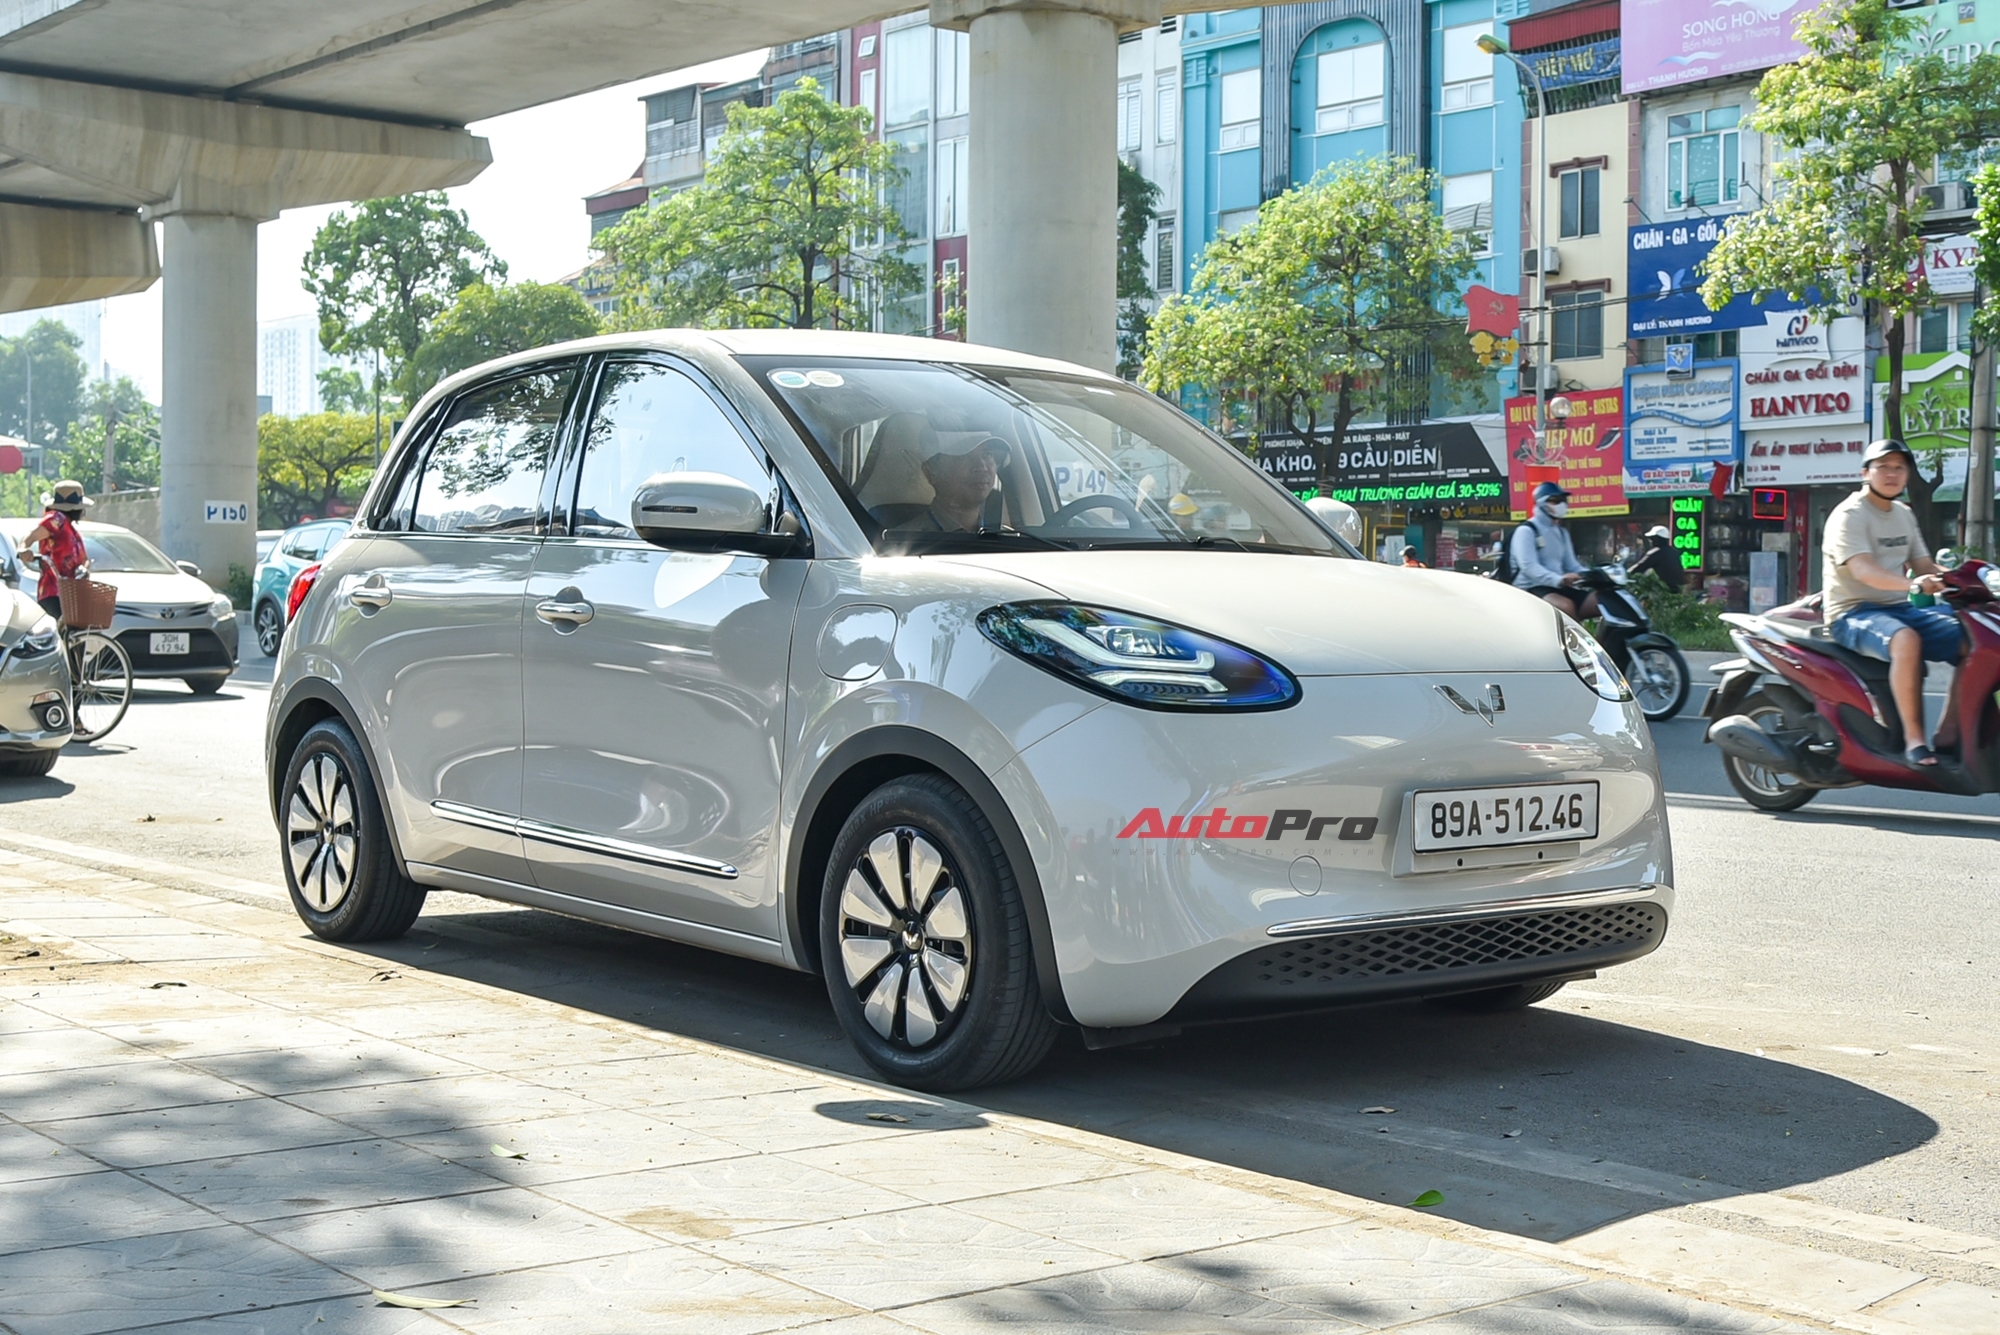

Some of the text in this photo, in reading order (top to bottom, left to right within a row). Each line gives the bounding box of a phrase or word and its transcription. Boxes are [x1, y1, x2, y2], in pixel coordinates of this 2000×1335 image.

[1634, 228, 1664, 250] CHĂN
[1672, 231, 1688, 245] GA
[1698, 218, 1717, 241] GỐI
[1745, 367, 1779, 385] CHĂN
[1783, 369, 1801, 382] GA
[1805, 361, 1828, 380] GỐI
[1750, 392, 1851, 418] HANVICO
[1546, 422, 1596, 453] IỆP MƠ
[1351, 443, 1388, 469] CẦU
[1393, 438, 1437, 466] DIỄN
[1436, 480, 1456, 499] GIÁ
[1457, 482, 1501, 498] 30-50%
[1672, 497, 1703, 512] CHĂN
[1676, 517, 1698, 530] GA
[1673, 532, 1699, 549] GỐI
[1680, 551, 1702, 569] ỆM
[1431, 793, 1583, 839] 89A-512.46
